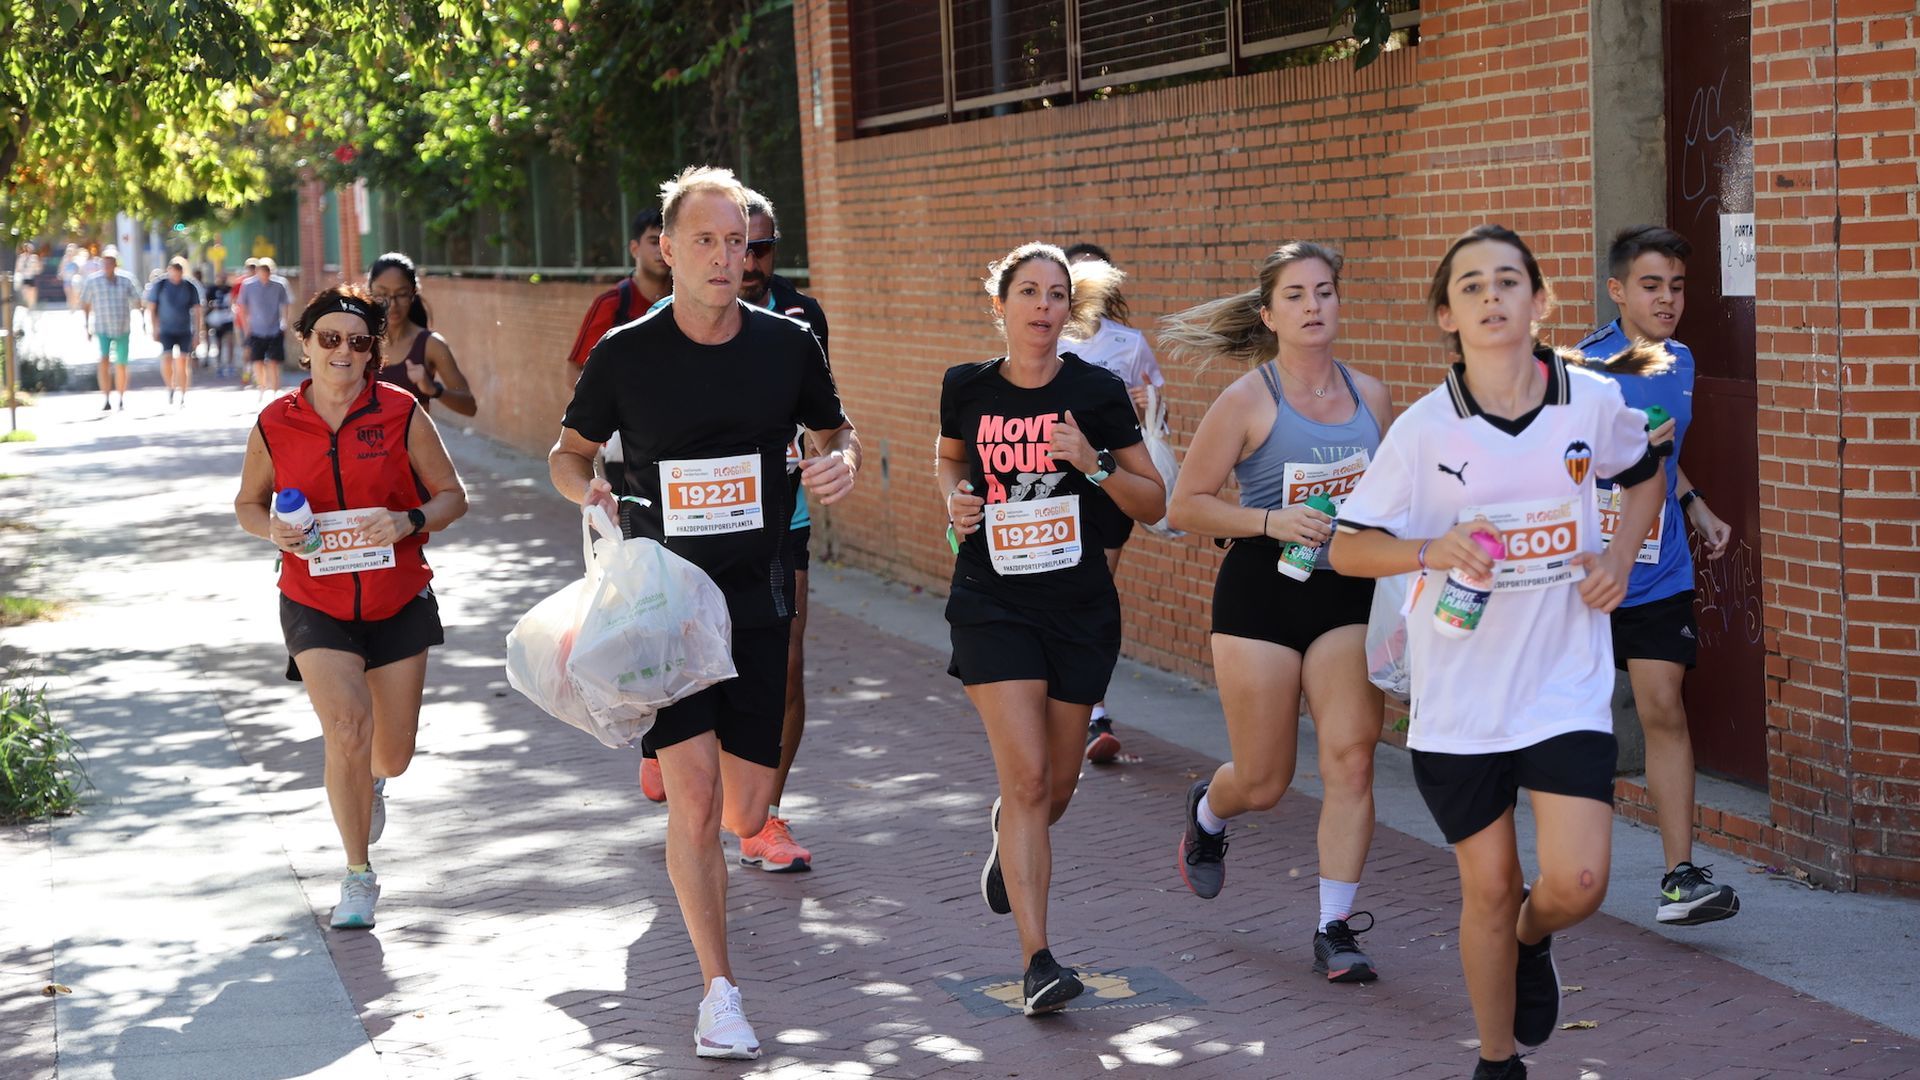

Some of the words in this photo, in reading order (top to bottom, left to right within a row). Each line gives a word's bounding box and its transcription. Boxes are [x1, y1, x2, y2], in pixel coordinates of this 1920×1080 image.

[977, 413, 1058, 443] MOVE
[976, 443, 1057, 473] YOUR
[678, 481, 745, 506] 19221
[998, 521, 1069, 547] 19220
